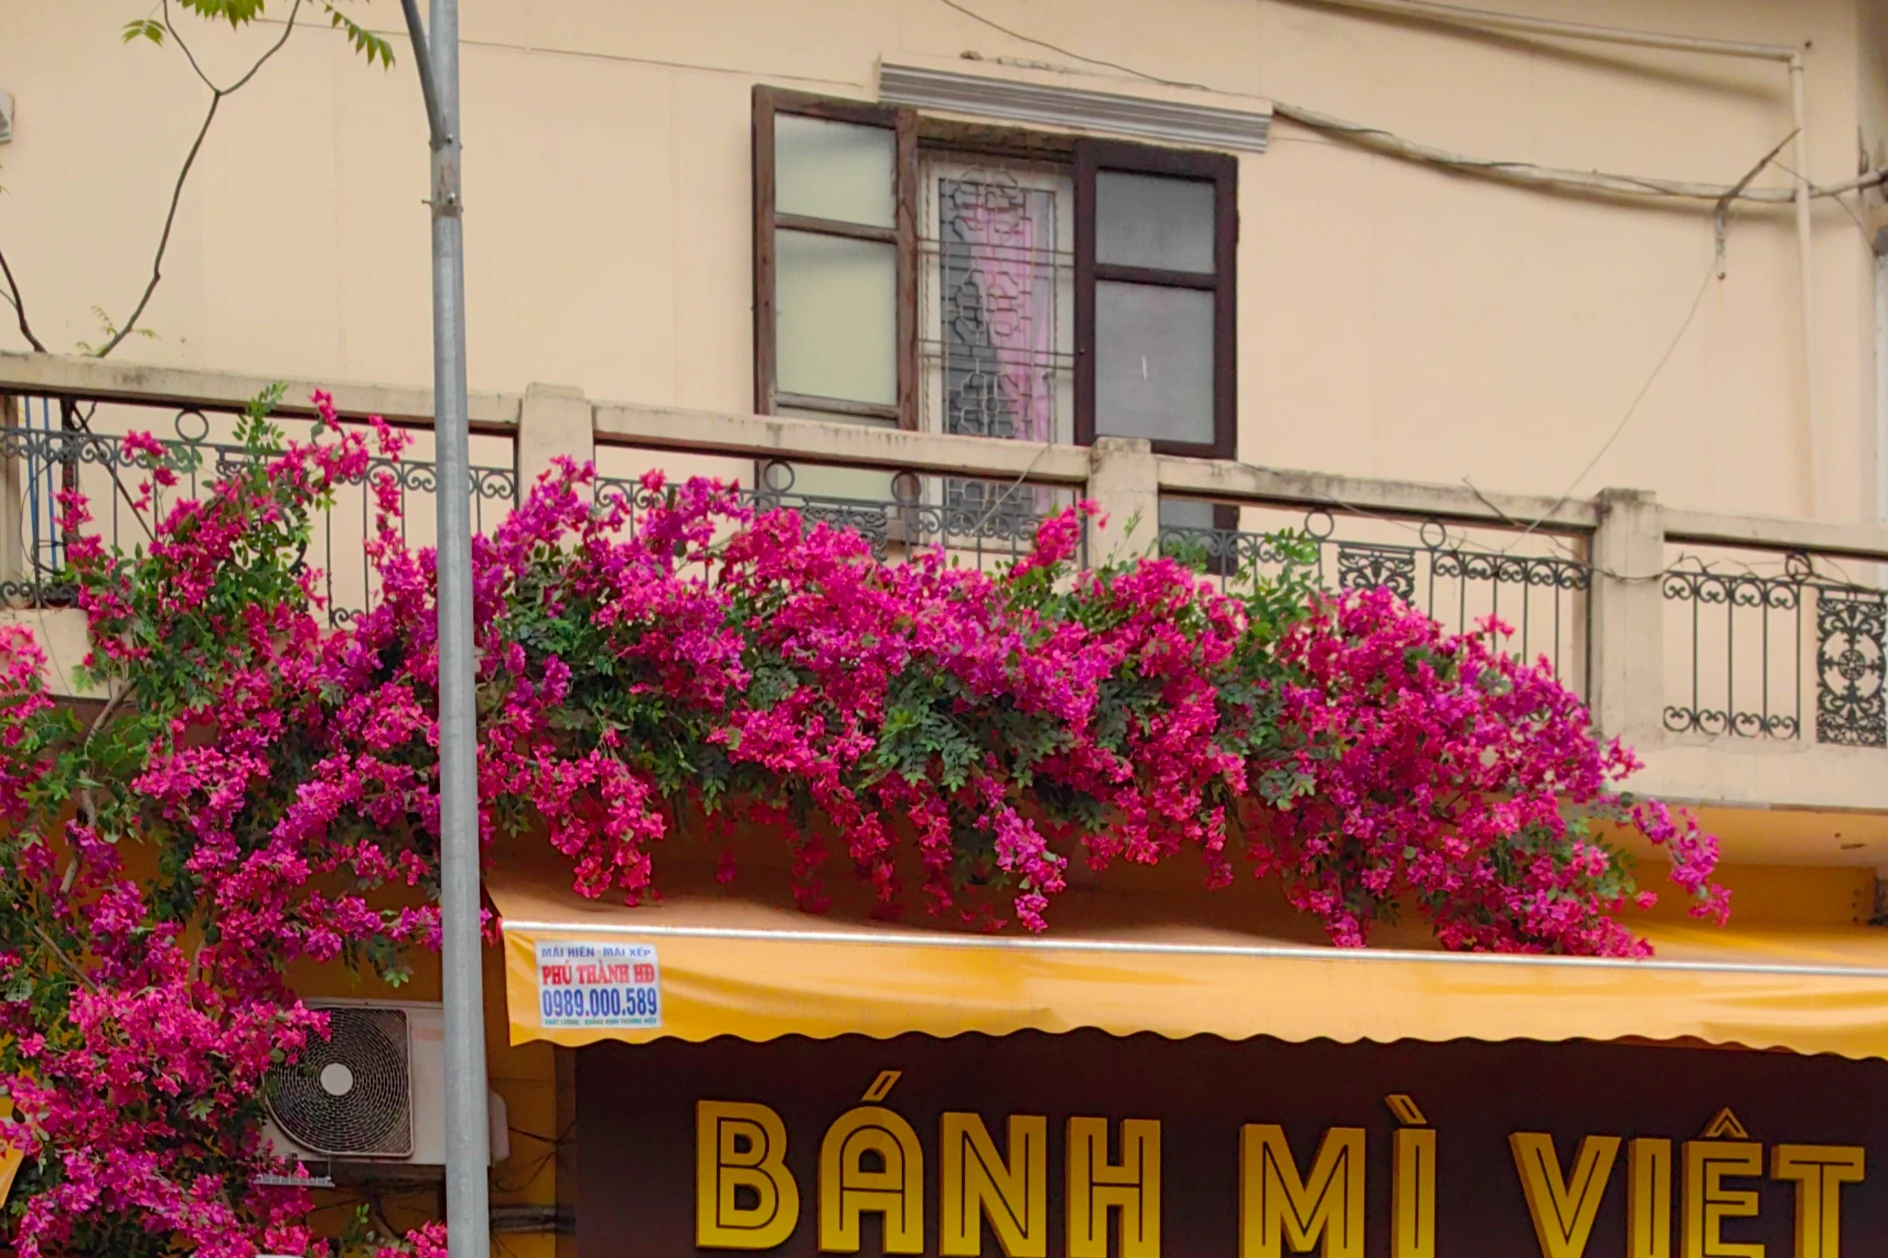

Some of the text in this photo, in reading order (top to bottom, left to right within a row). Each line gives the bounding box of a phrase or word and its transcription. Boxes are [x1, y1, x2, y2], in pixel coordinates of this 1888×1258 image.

[541, 959, 572, 985] PHÚ
[576, 958, 630, 984] THÀNH
[542, 986, 657, 1017] 0989.000.589
